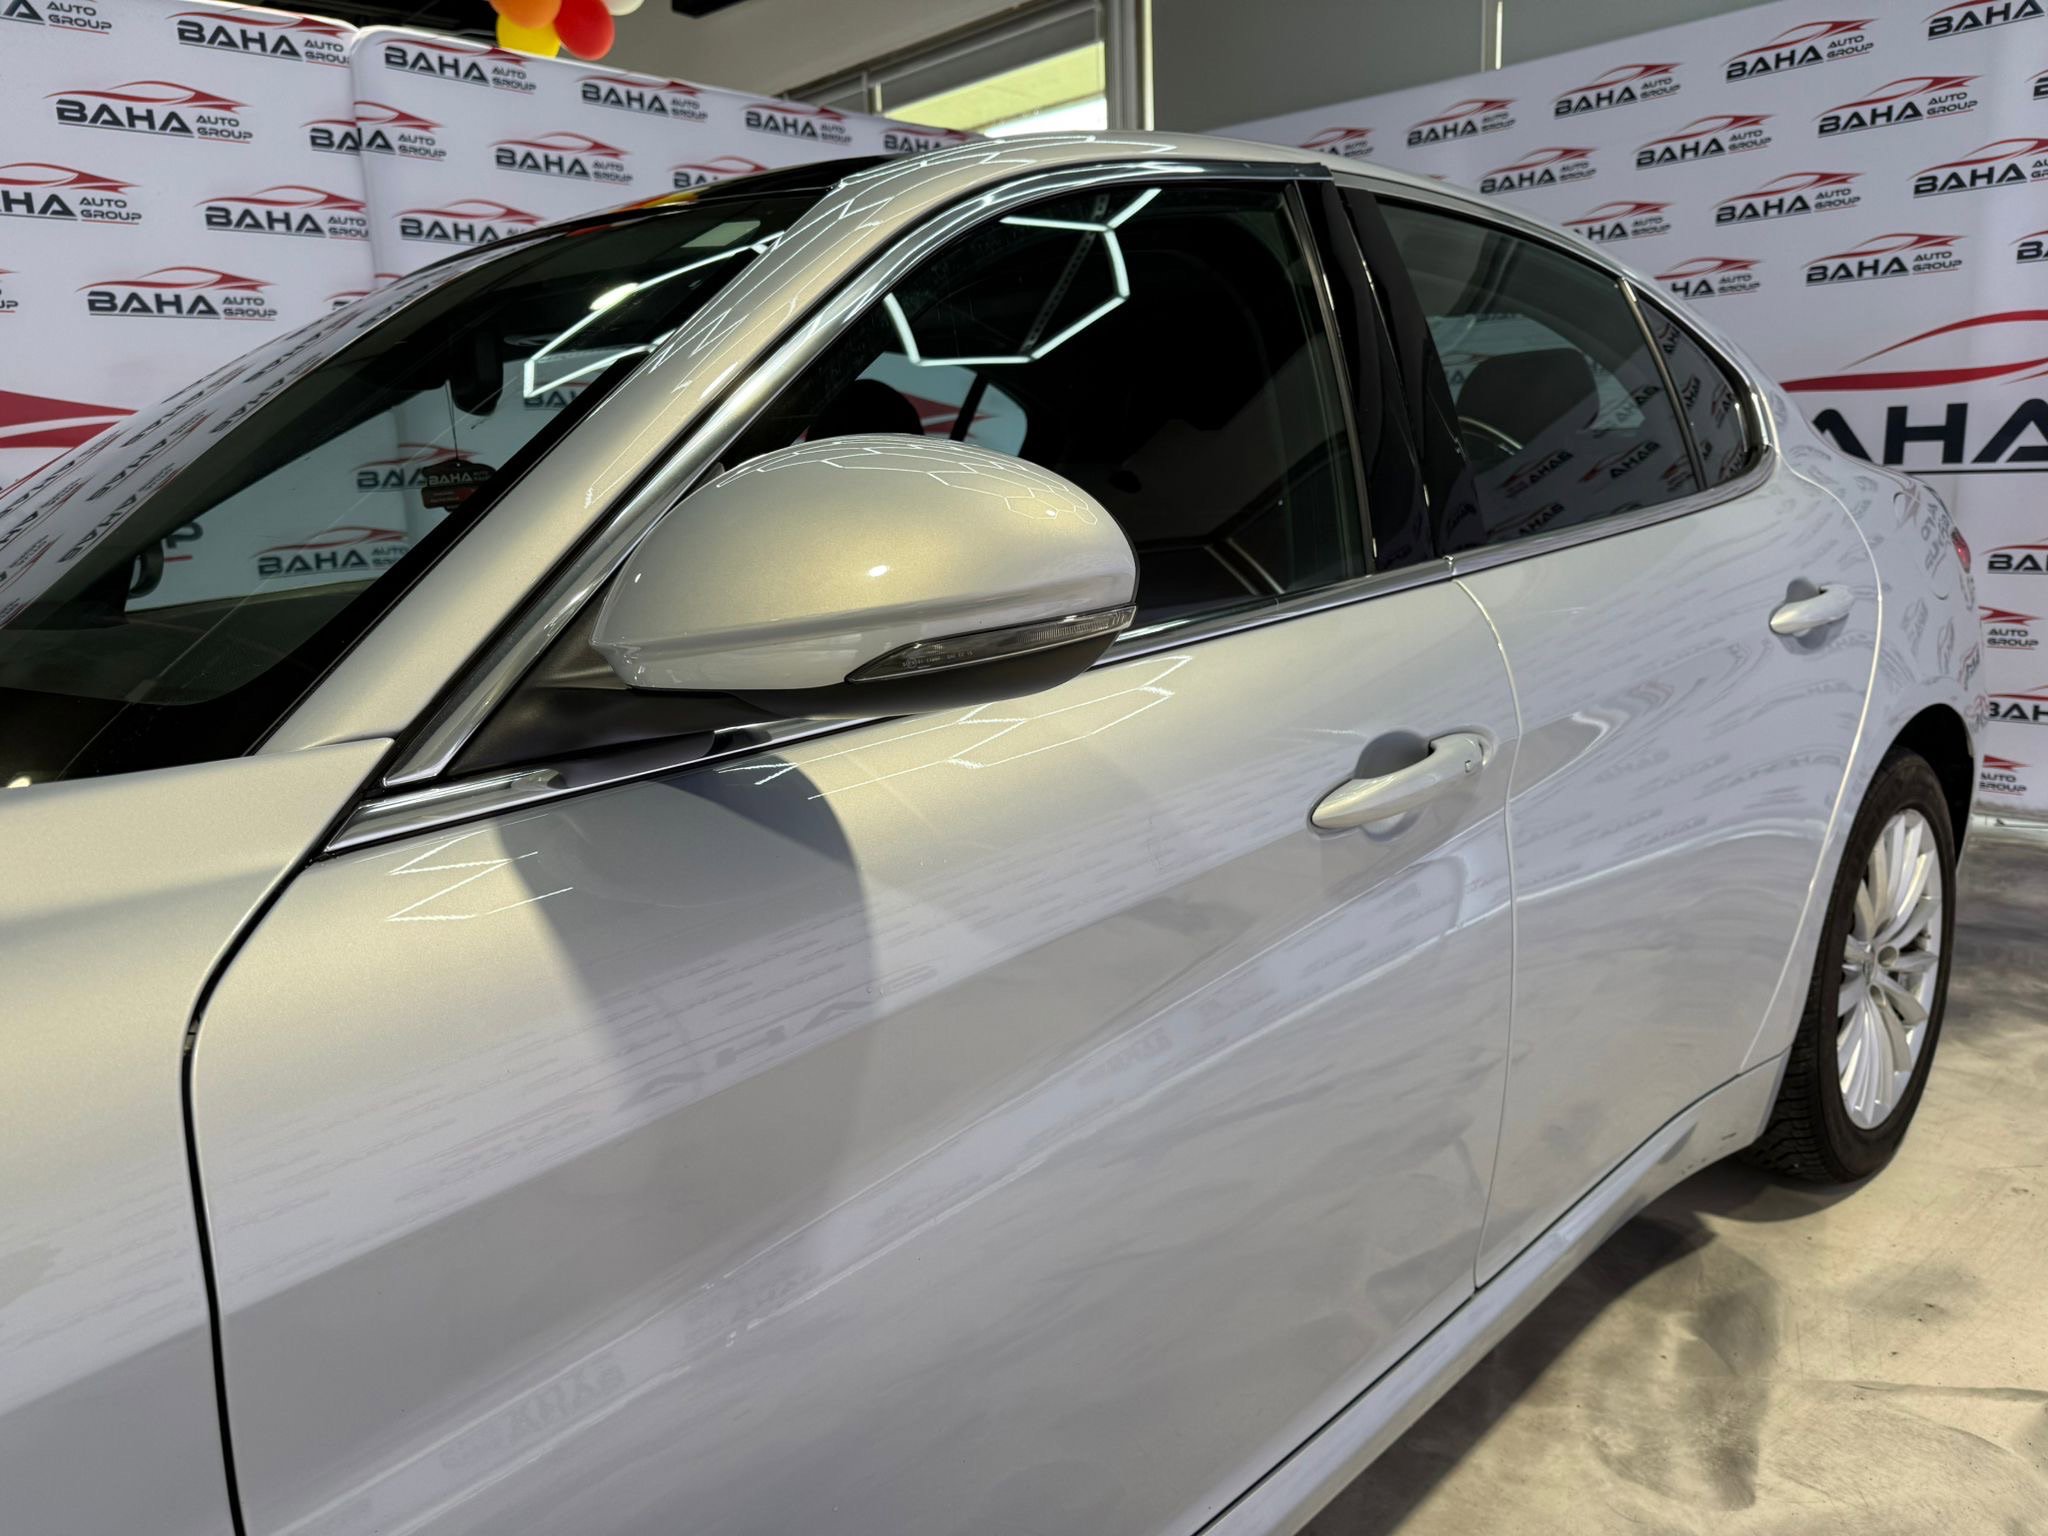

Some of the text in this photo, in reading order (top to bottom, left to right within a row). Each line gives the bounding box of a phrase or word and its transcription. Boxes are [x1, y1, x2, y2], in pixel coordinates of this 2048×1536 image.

[46, 1, 97, 17] AUTO
[48, 14, 112, 30] GROUP
[1928, 0, 2045, 37] BAHA
[177, 20, 302, 57] BAHA
[304, 39, 344, 53] AUTO
[1827, 35, 1865, 50] AUTO
[305, 50, 350, 64] GROU
[1827, 42, 1875, 59] GROUP
[384, 46, 490, 83] BAHA
[1726, 45, 1824, 81] BAHA
[491, 66, 527, 80] AUTO
[492, 77, 536, 92] GROUP
[1640, 77, 1673, 91] AUTO
[1640, 83, 1681, 100] GROUP
[582, 83, 669, 115] BAHA
[671, 98, 700, 110] AUTO
[1554, 87, 1637, 118] BAHA
[1927, 91, 1968, 106] AUTO
[1927, 100, 1979, 117] GROUP
[56, 99, 193, 134] BAHA
[196, 115, 240, 128] AUTO
[1818, 101, 1923, 136] BAHA
[746, 110, 819, 139] BAHA
[197, 126, 253, 141] GROUP
[398, 134, 436, 146] AUTO
[1407, 120, 1479, 147] BAHA
[1729, 129, 1763, 143] AUTO
[398, 145, 447, 158] GROUP
[1728, 137, 1772, 152] GROUP
[1636, 138, 1726, 170] BAHA
[495, 148, 590, 177] BAHA
[593, 160, 624, 172] AUTO
[1480, 168, 1557, 195] BAHA
[1913, 163, 2027, 195] BAHA
[1815, 188, 1851, 201] AUTO
[79, 196, 127, 209] AUTO
[1715, 195, 1812, 225] BAHA
[1815, 196, 1861, 210] GROUP
[80, 209, 142, 221] GROUP
[205, 206, 326, 235] BAHA
[328, 216, 367, 227] AUTO
[328, 227, 369, 238] GROU
[400, 218, 500, 243] BAHA
[1912, 251, 1953, 264] AUTO
[1806, 257, 1909, 285] BAHA
[1912, 259, 1962, 274] GROUP
[87, 291, 221, 316] BAHA
[223, 296, 264, 307] AUTO
[223, 307, 277, 319] GROUP
[1813, 398, 2048, 465] AHA
[429, 473, 472, 486] BAHA
[258, 550, 369, 576] BAHA
[1988, 628, 2028, 638] AUTO
[1987, 638, 2039, 647] GROUP
[1989, 702, 2048, 721] BAH
